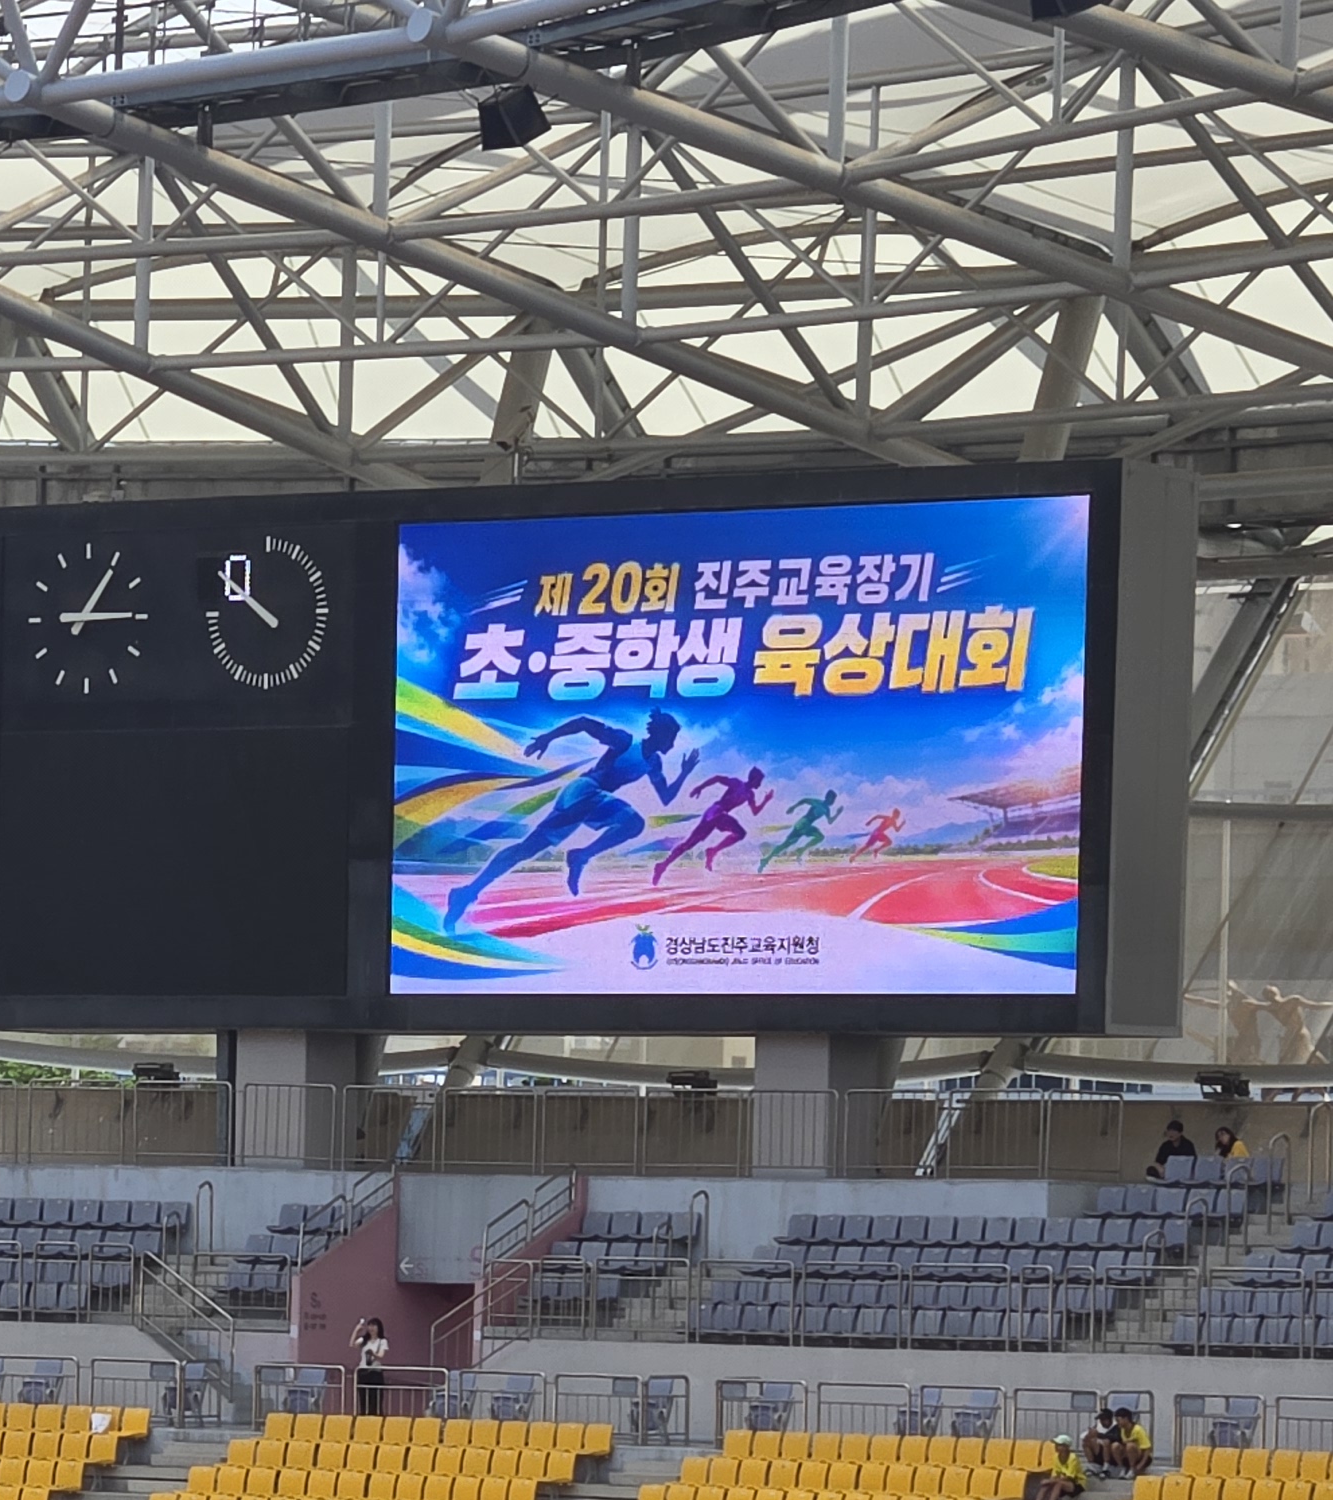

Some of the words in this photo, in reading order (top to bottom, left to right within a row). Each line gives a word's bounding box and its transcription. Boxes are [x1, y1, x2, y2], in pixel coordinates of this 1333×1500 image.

[536, 573, 571, 616] 제
[579, 561, 678, 615] 20회
[695, 553, 935, 609] 진주교육장기
[754, 606, 1033, 696] 육상대회
[665, 935, 819, 954] 경상남도진주교육지원청
